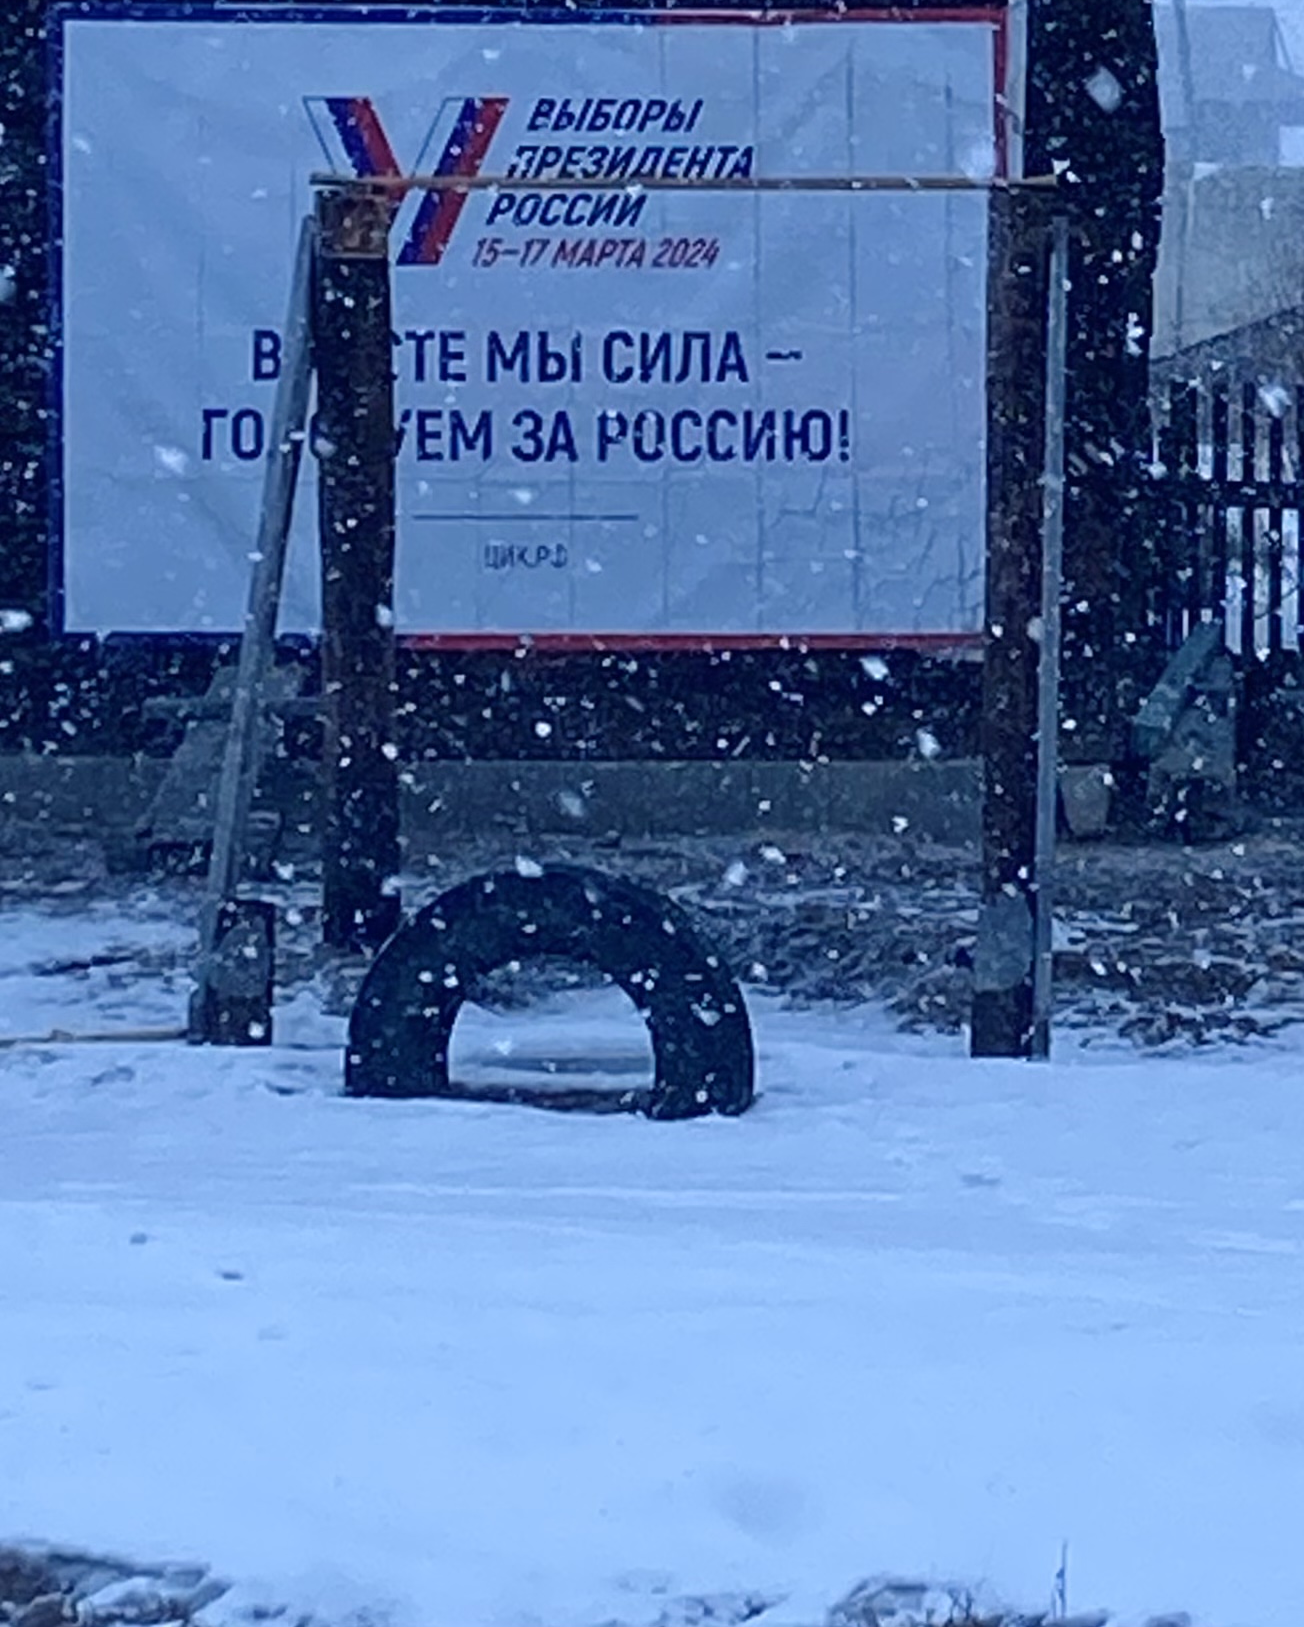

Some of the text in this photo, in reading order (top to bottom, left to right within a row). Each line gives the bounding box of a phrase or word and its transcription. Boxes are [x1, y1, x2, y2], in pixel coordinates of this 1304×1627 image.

[527, 98, 704, 132] ВЫБОРЫ
[505, 145, 755, 180] ПРЕЗИДЕНТА
[486, 193, 648, 227] РОССИИ
[551, 237, 647, 269] МАРТА
[652, 236, 720, 269] 2024
[487, 330, 582, 383] МЫ
[602, 330, 750, 383] СИЛА
[511, 409, 579, 462] ЗА
[597, 409, 850, 463] РОССИЮ!
